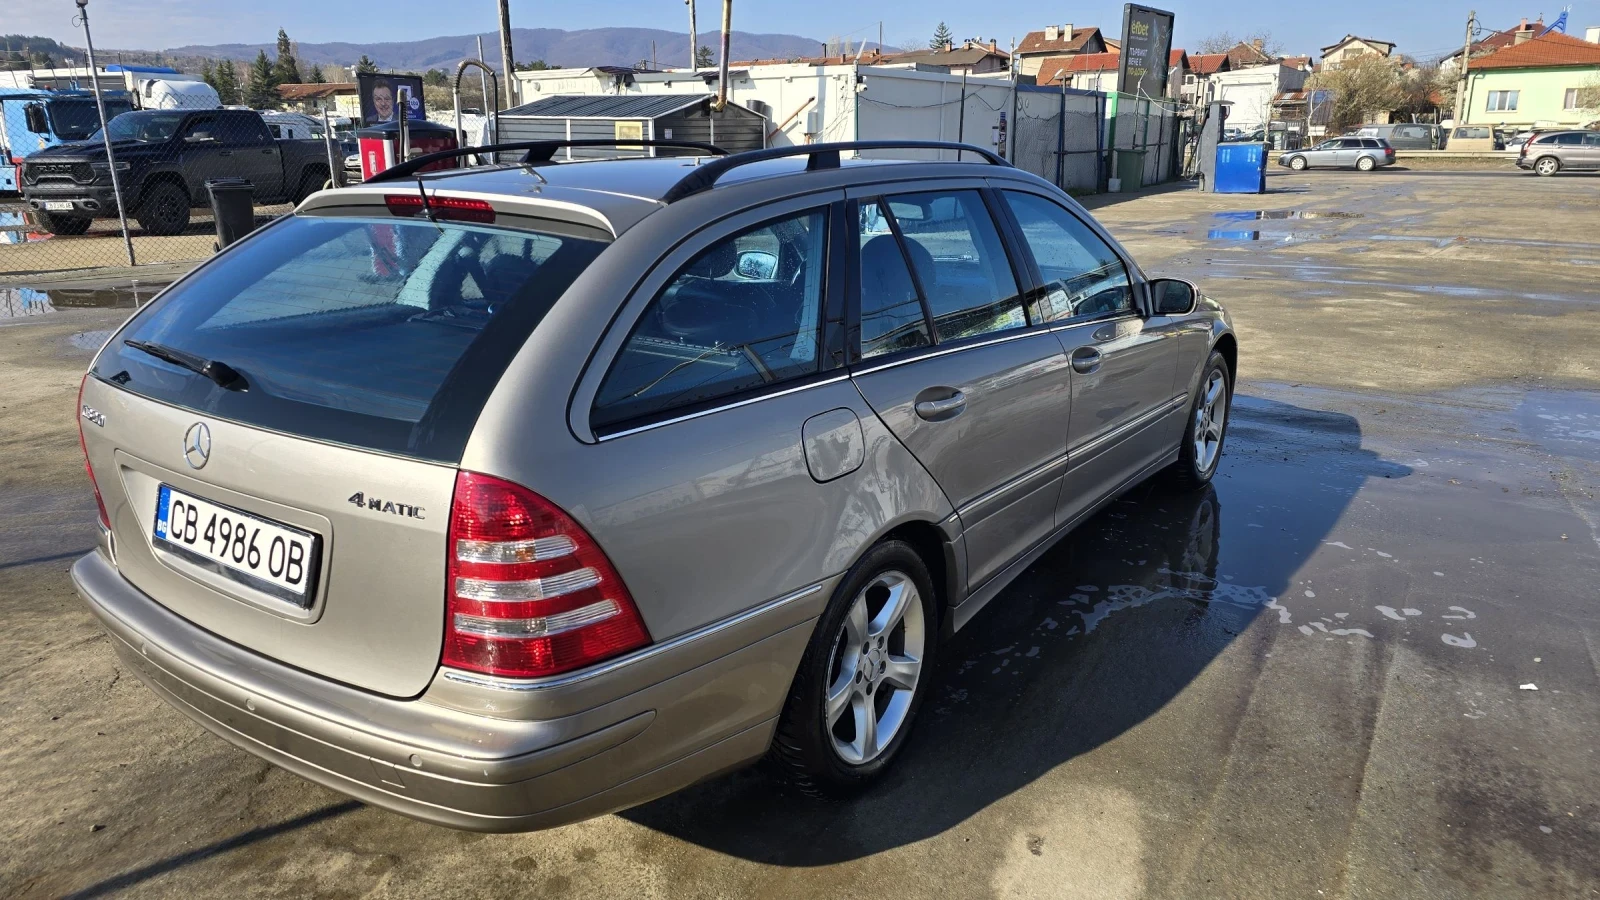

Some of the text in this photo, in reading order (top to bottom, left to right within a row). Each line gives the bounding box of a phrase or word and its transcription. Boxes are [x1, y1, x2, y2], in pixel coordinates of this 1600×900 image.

[1131, 21, 1149, 36] efbet
[36, 164, 72, 172] RAM
[157, 519, 167, 532] BG
[170, 499, 304, 585] CB 4986 OB
